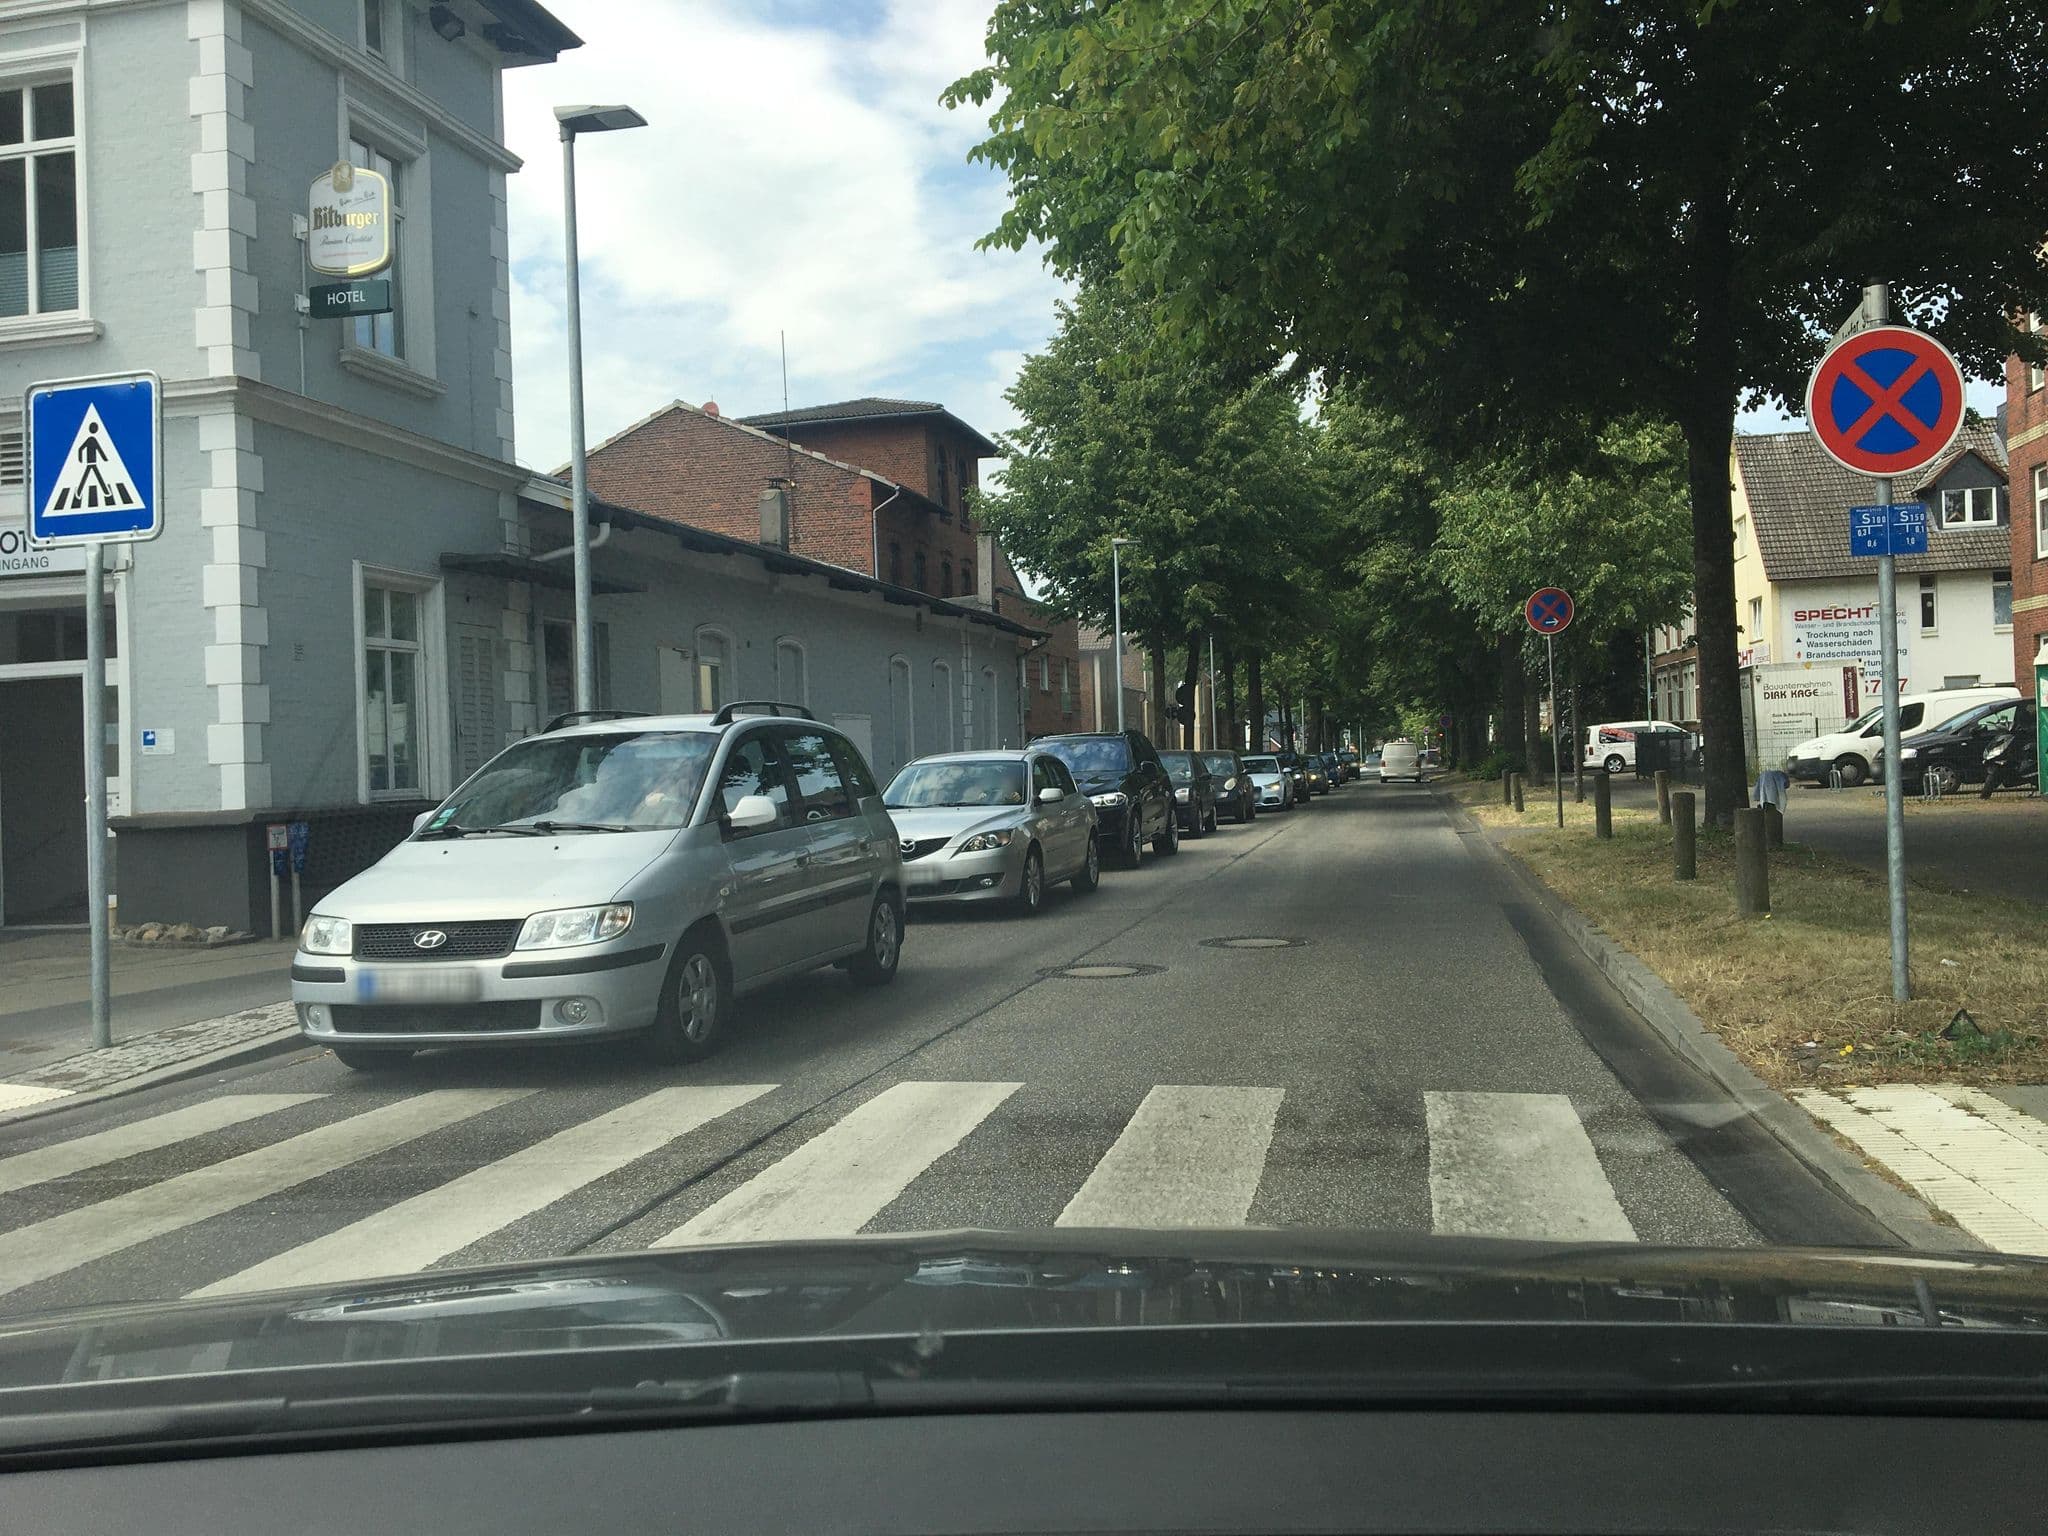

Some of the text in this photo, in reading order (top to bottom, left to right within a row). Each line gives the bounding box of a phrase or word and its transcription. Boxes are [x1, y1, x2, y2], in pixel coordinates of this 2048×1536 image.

[312, 205, 379, 231] Bitburger
[327, 290, 366, 305] HOTEL
[1795, 607, 1874, 621] SPECHT
[1806, 629, 1873, 639] Trocknung nach
[1763, 680, 1832, 691] Bauunternehmen
[1763, 690, 1787, 700] DIRK
[1791, 688, 1819, 698] KAGE
